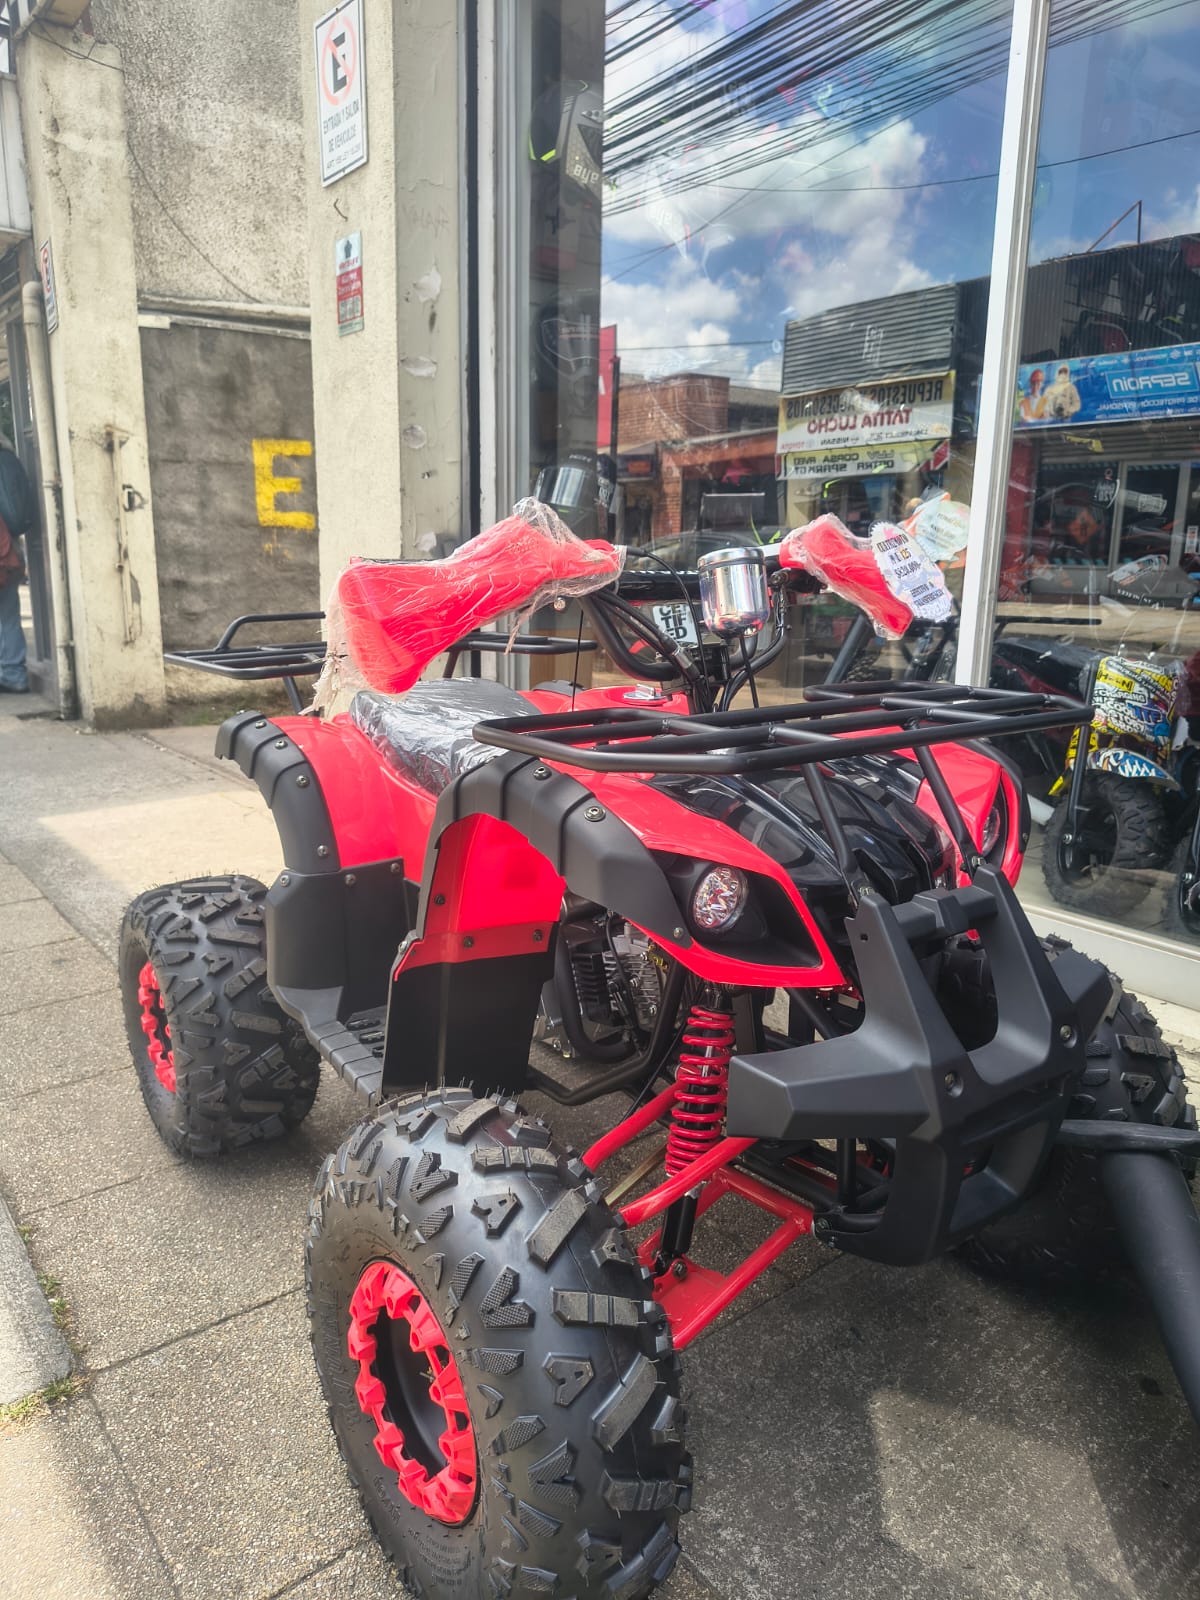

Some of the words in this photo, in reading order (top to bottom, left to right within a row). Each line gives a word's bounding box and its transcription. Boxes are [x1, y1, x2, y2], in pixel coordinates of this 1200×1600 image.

[323, 111, 341, 135] ENTRADA
[346, 98, 360, 121] SALIDA
[328, 137, 335, 153] DE
[252, 438, 316, 530] E
